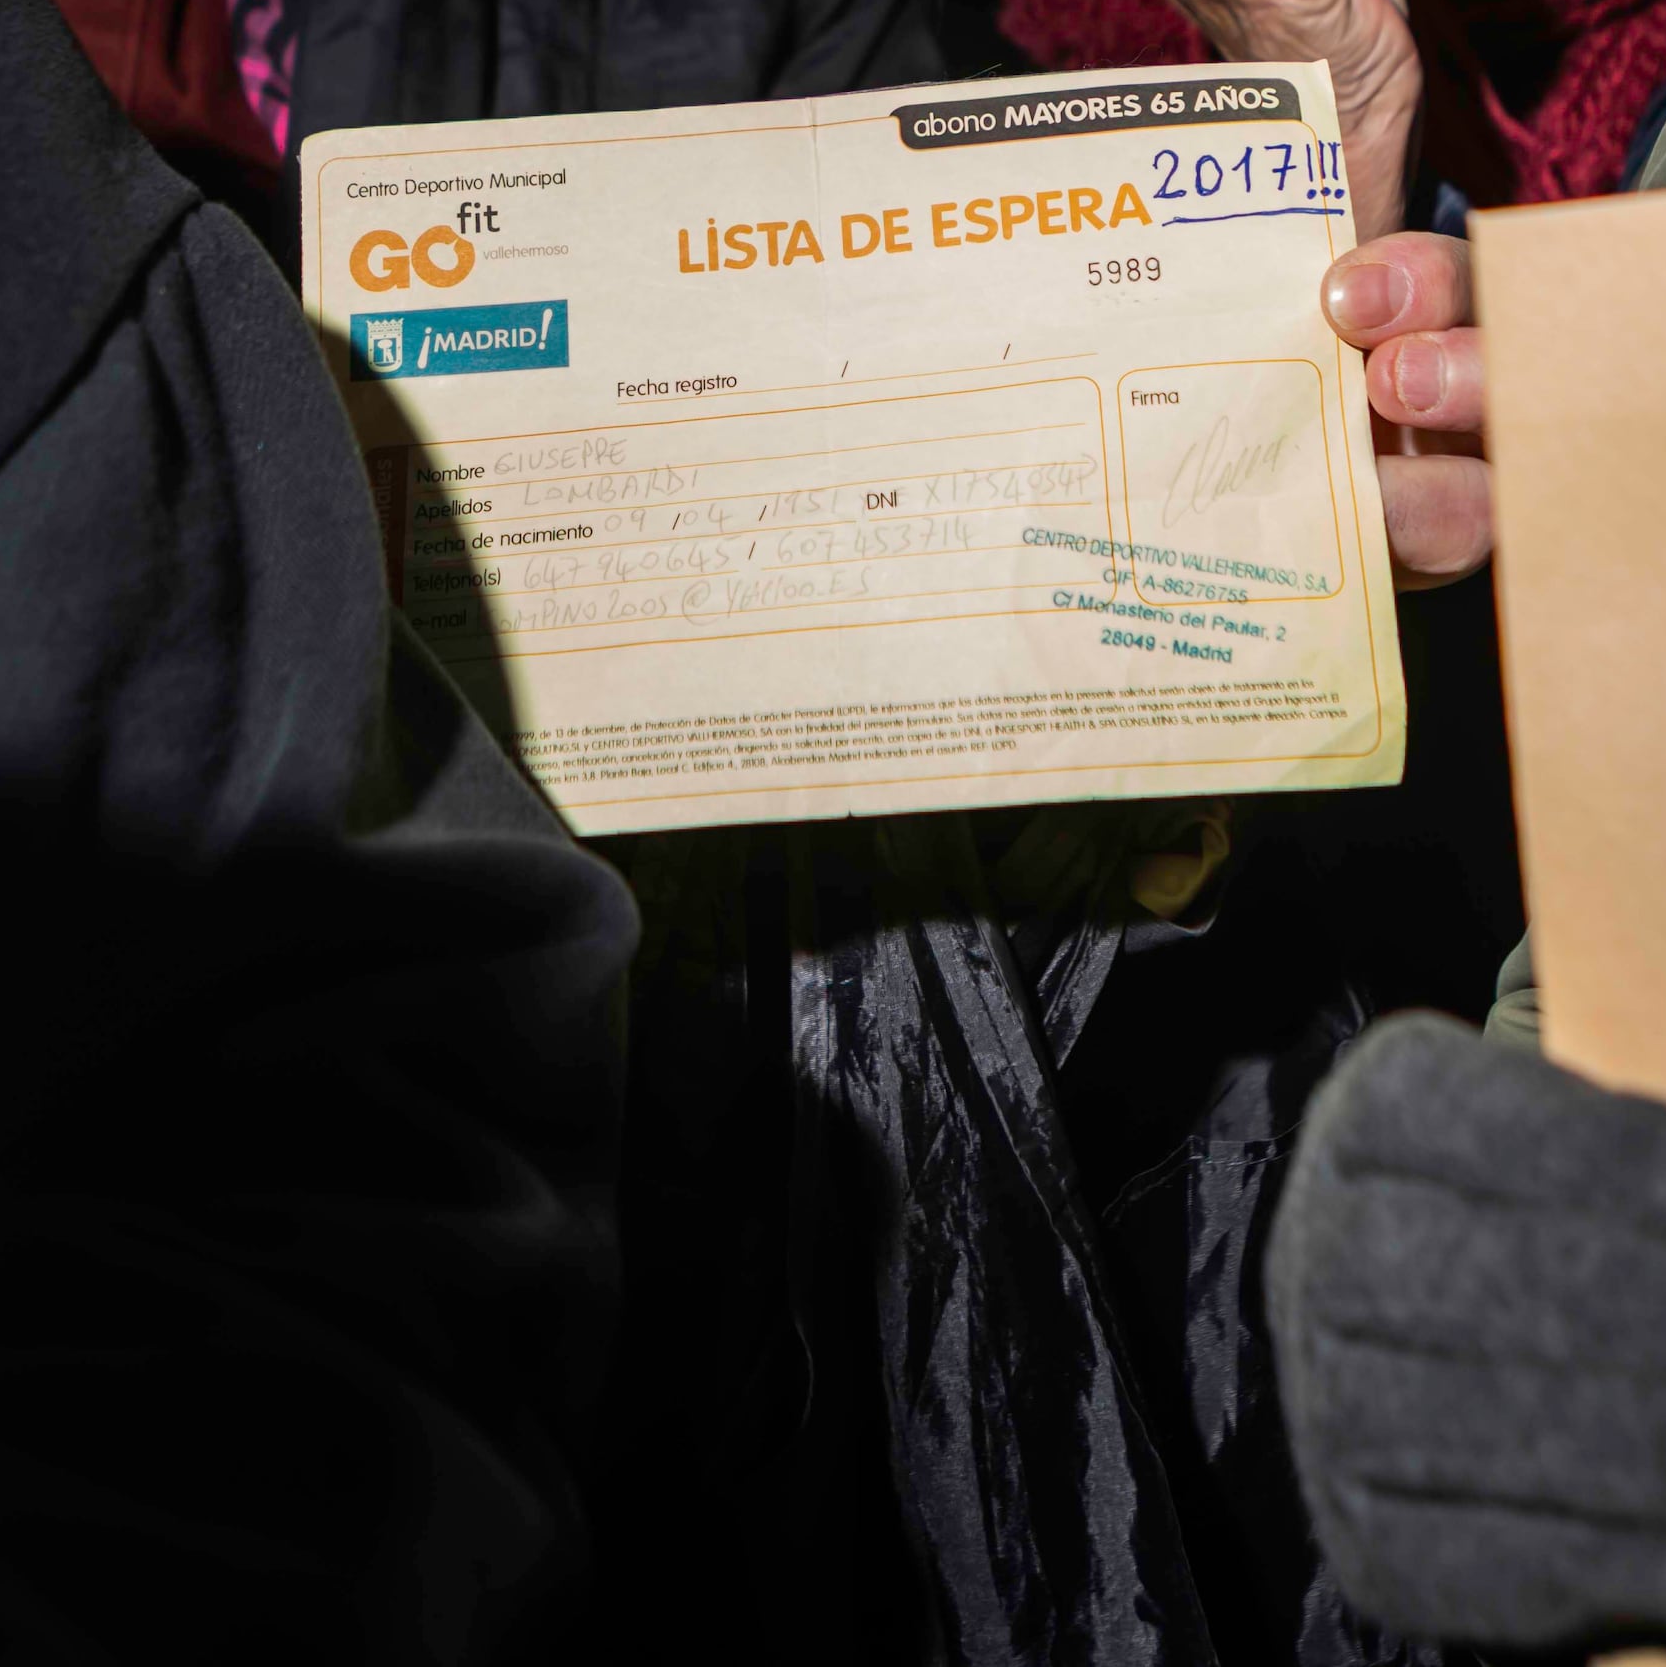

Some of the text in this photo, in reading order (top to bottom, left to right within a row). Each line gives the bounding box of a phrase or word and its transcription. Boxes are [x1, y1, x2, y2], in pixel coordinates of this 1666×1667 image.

[913, 85, 1280, 138] abono MAYORES 65 AÑOS
[347, 168, 566, 199] Centro Deportivo Municipal
[457, 201, 501, 235] fit
[840, 208, 913, 260] DE
[932, 183, 1154, 249] ESPERA
[349, 224, 476, 292] GO
[483, 243, 570, 262] vallehermoso
[1087, 256, 1163, 287] 5989
[417, 308, 553, 370] ¡MADRID!
[617, 379, 669, 398] Fecha
[675, 374, 738, 396] registro
[1131, 389, 1180, 407] Firma
[494, 438, 628, 475] GIUSEPPE
[416, 464, 485, 483] Nombre
[524, 464, 698, 507] LOMBARDI
[415, 498, 493, 522] Apellidos
[865, 491, 898, 511] DNI
[413, 524, 594, 557] Fecha de nacimiento
[1022, 527, 1087, 553] CENTRO
[1090, 539, 1177, 568] DEPORTIVO
[1181, 552, 1301, 591] VALLEHERMOSO,
[412, 567, 501, 594] Teléfono(s)
[1142, 575, 1249, 605] A-86276755
[412, 609, 467, 630] e-mail
[1078, 595, 1174, 624] Monasterio
[1179, 611, 1206, 629] del
[1212, 616, 1270, 641] Paular,
[1275, 626, 1288, 643] 2
[1100, 628, 1156, 652] 28049
[1172, 640, 1233, 664] Madrid
[591, 739, 629, 749] CENTRO
[632, 734, 684, 746] DEPORTIVO
